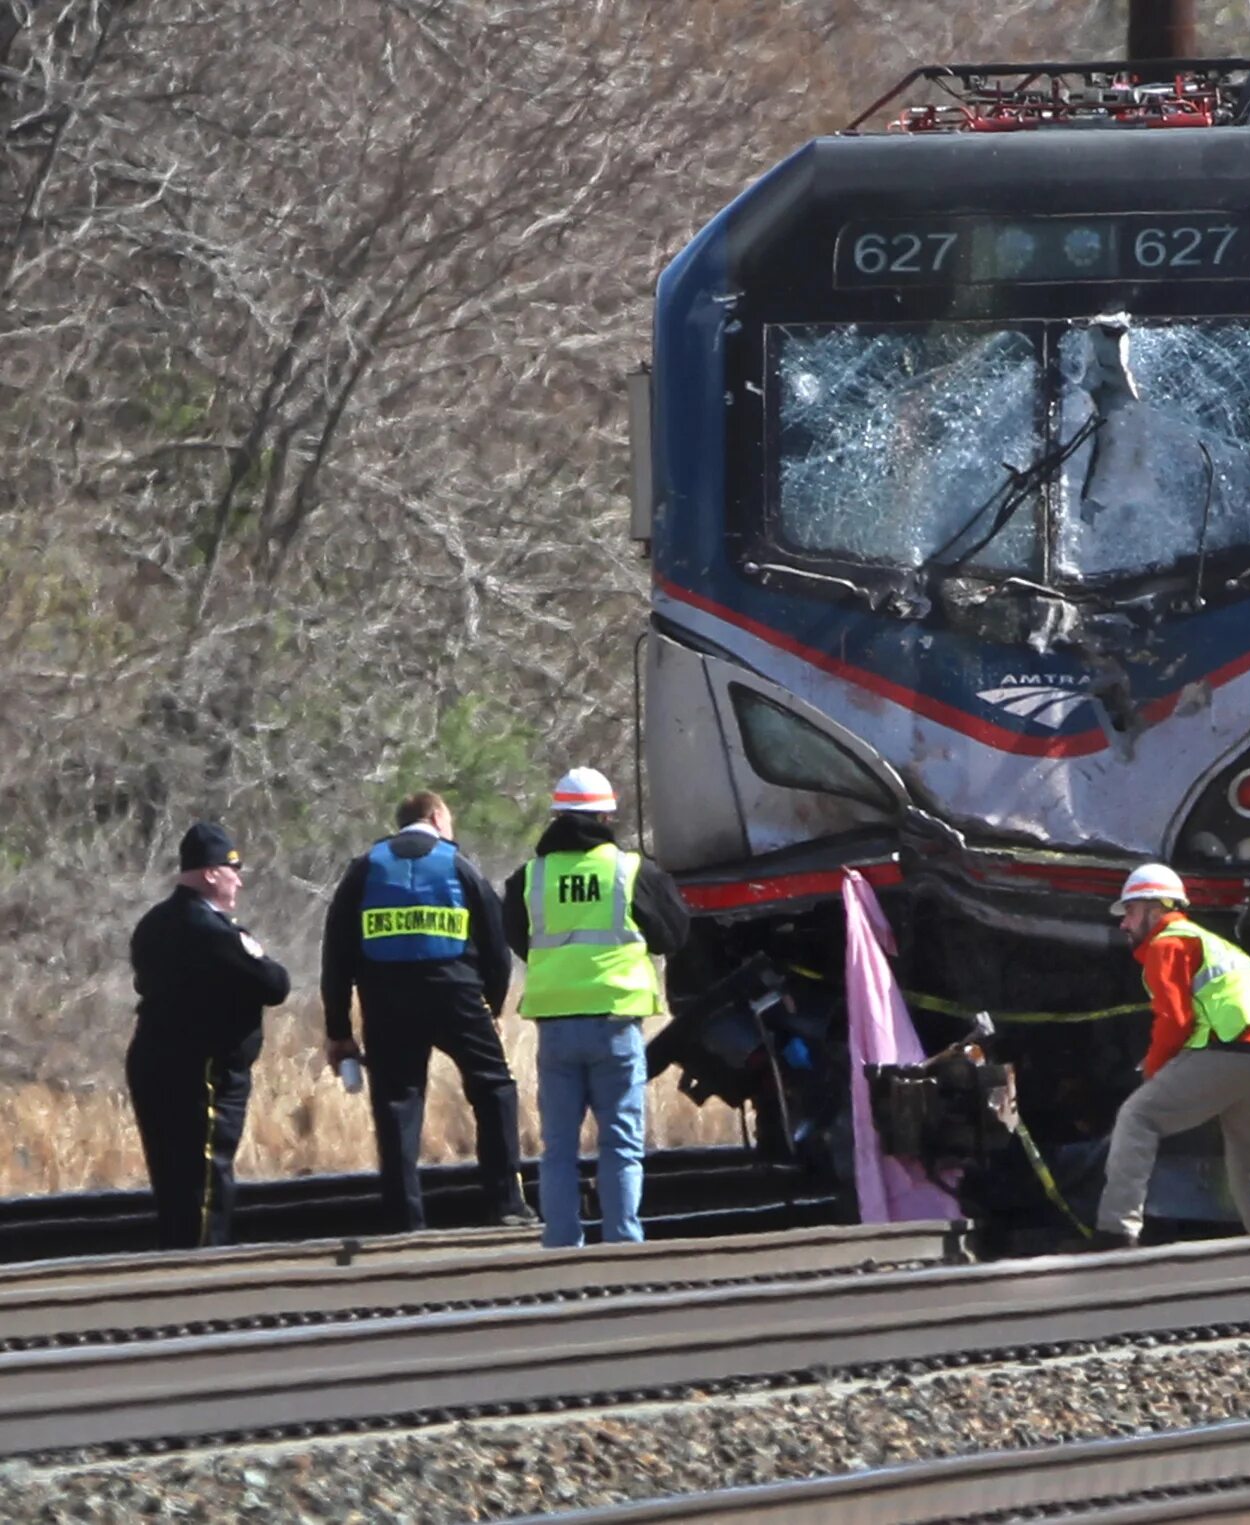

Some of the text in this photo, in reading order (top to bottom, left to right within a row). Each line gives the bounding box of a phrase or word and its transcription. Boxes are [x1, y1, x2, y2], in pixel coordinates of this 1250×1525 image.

[852, 232, 959, 275] 627
[1133, 226, 1239, 267] 627
[1001, 673, 1091, 685] AMTRA
[558, 873, 601, 903] FRA
[367, 909, 464, 934] EMS COMMAND
